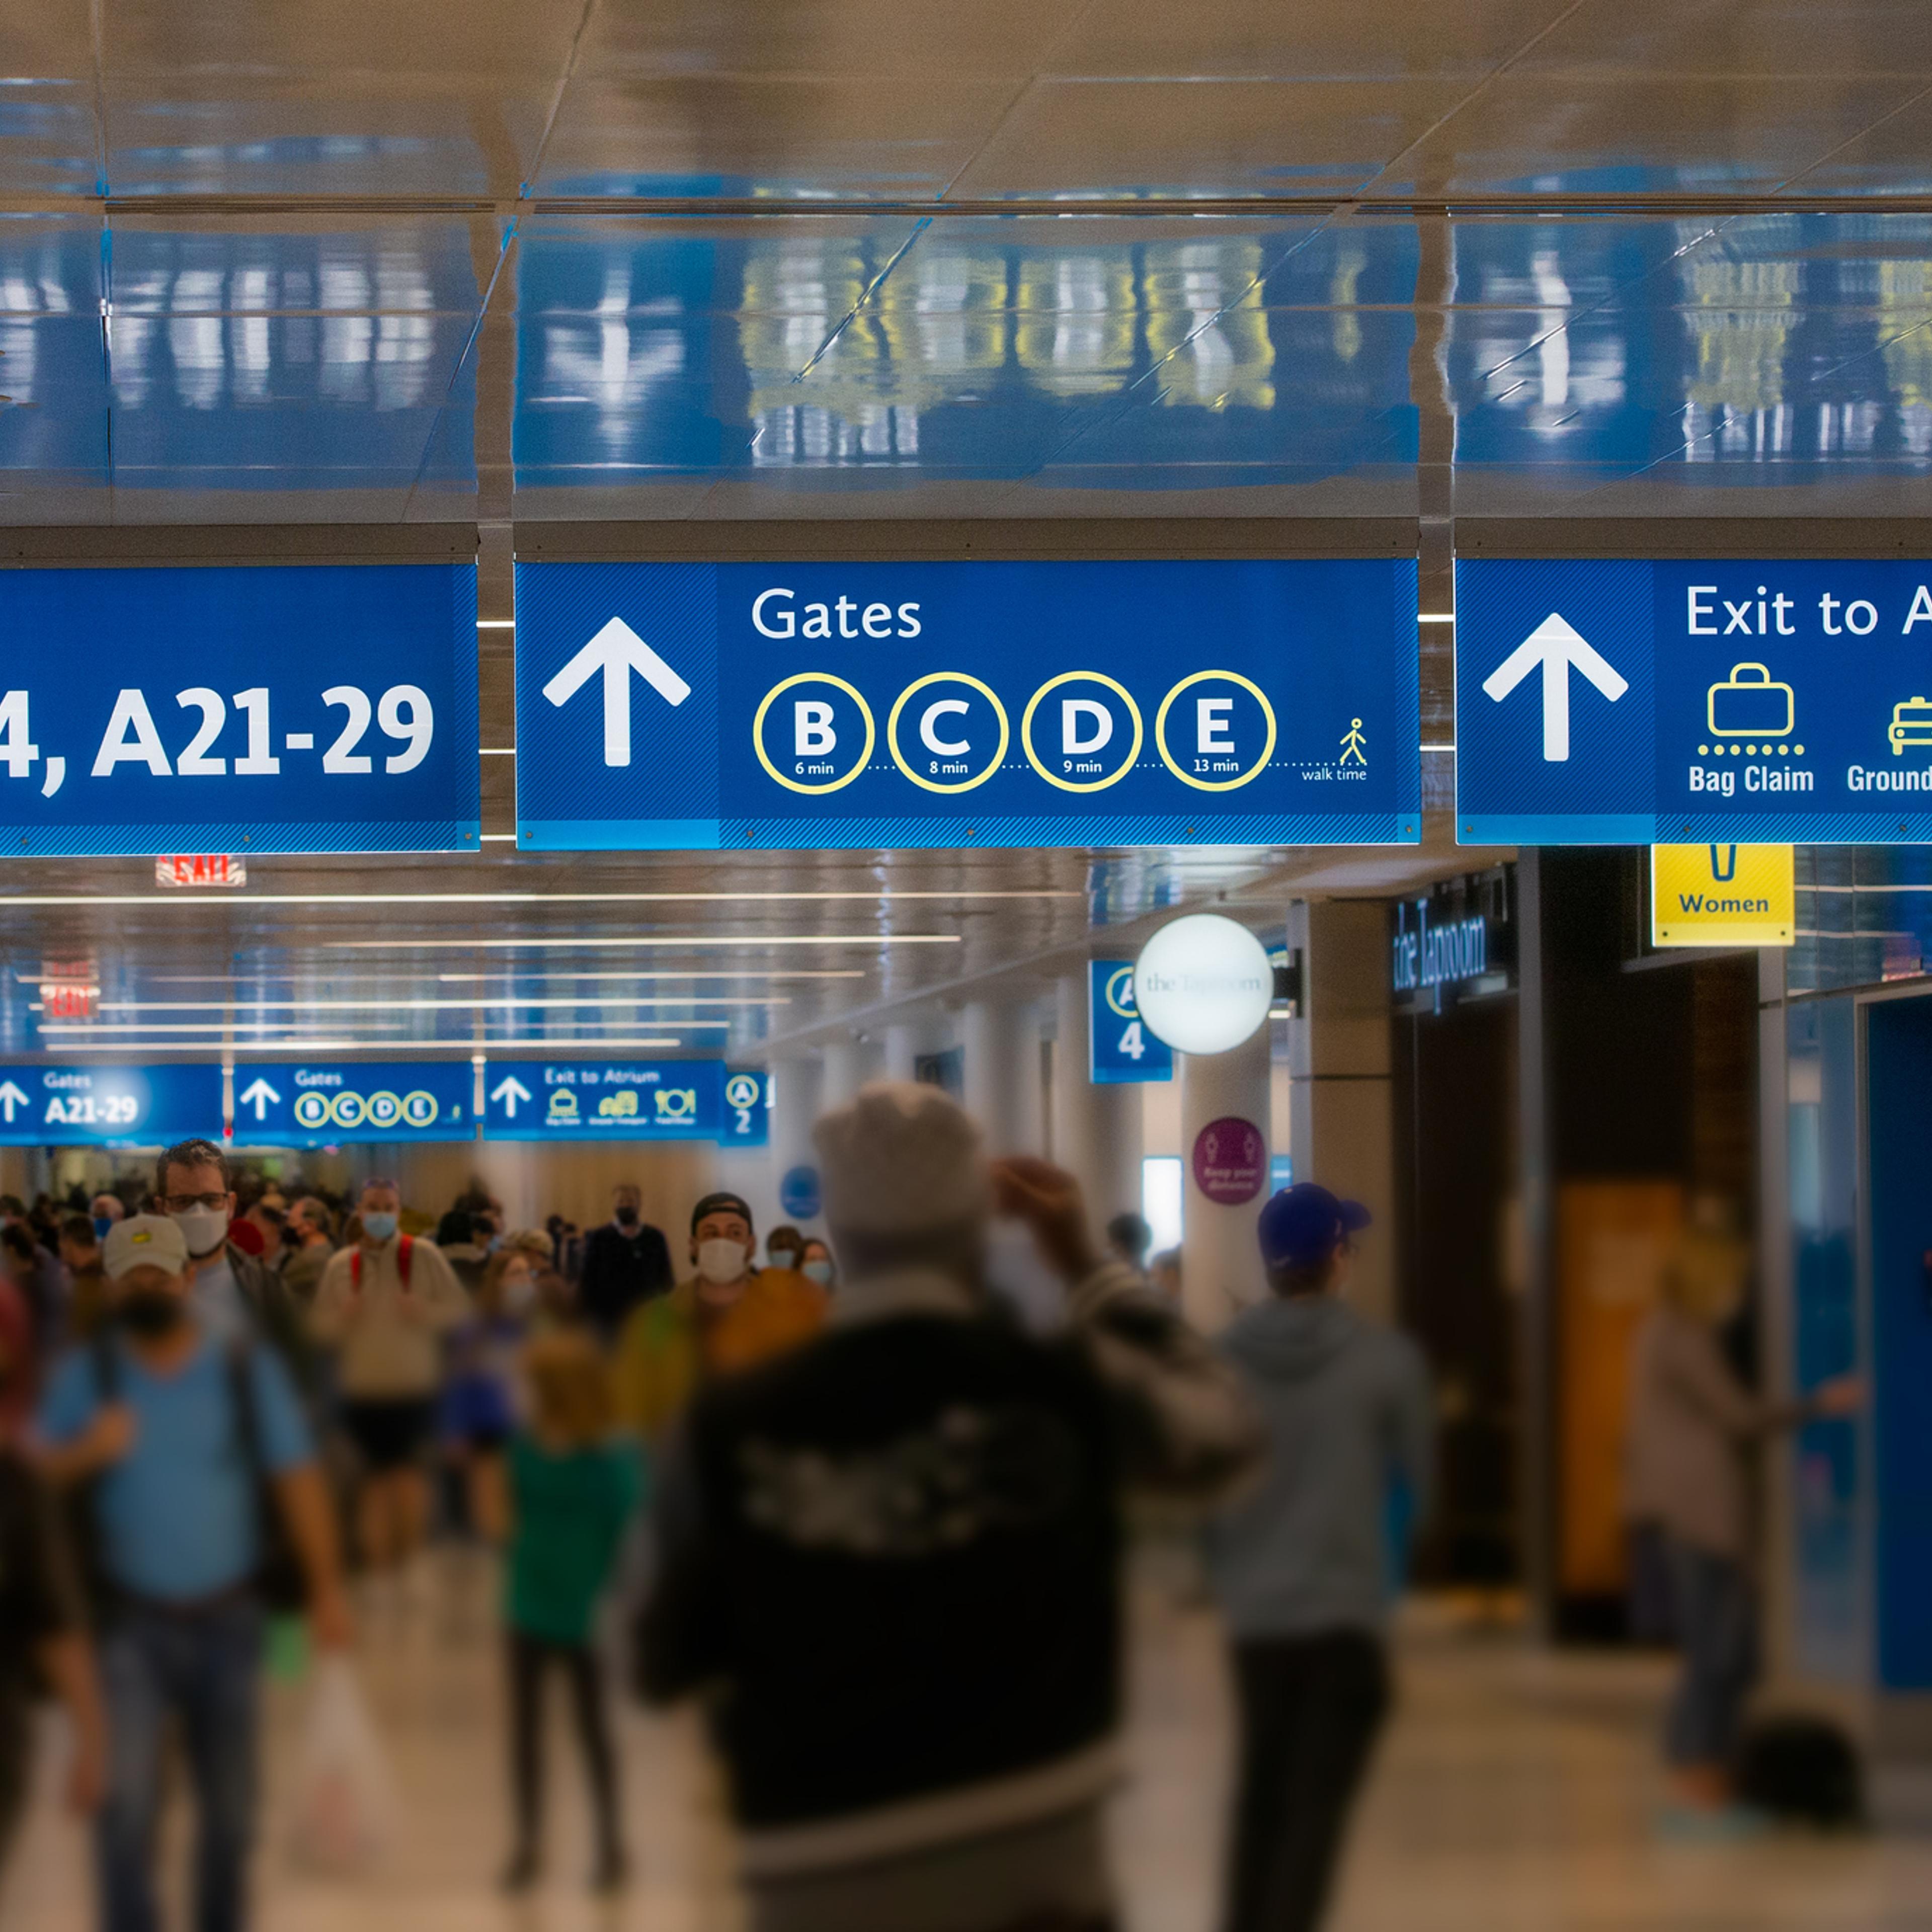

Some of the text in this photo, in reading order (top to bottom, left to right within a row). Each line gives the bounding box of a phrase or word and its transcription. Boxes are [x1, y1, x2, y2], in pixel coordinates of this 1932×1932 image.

[752, 588, 921, 639] Gates
[1688, 586, 1796, 635] Exit
[1818, 592, 1878, 635] to
[91, 685, 433, 776] A21-29
[795, 698, 1235, 756] B C D E
[795, 762, 834, 774] 6 min
[929, 761, 968, 774] 8 min
[1064, 760, 1102, 773] 9 min
[1194, 759, 1239, 772] 13 min
[1302, 768, 1366, 780] walk time
[1689, 765, 1814, 797] Bag Claim
[1847, 765, 1932, 791] Ground
[1678, 893, 1769, 913] Women
[1118, 1021, 1145, 1060] 4
[43, 1072, 92, 1089] Gates
[295, 1070, 343, 1086] Gates
[545, 1068, 660, 1084] Exit to Atrium
[734, 1082, 751, 1101] A
[45, 1095, 138, 1123] A21-29
[305, 1098, 426, 1119] B C D E
[735, 1109, 751, 1134] 2
